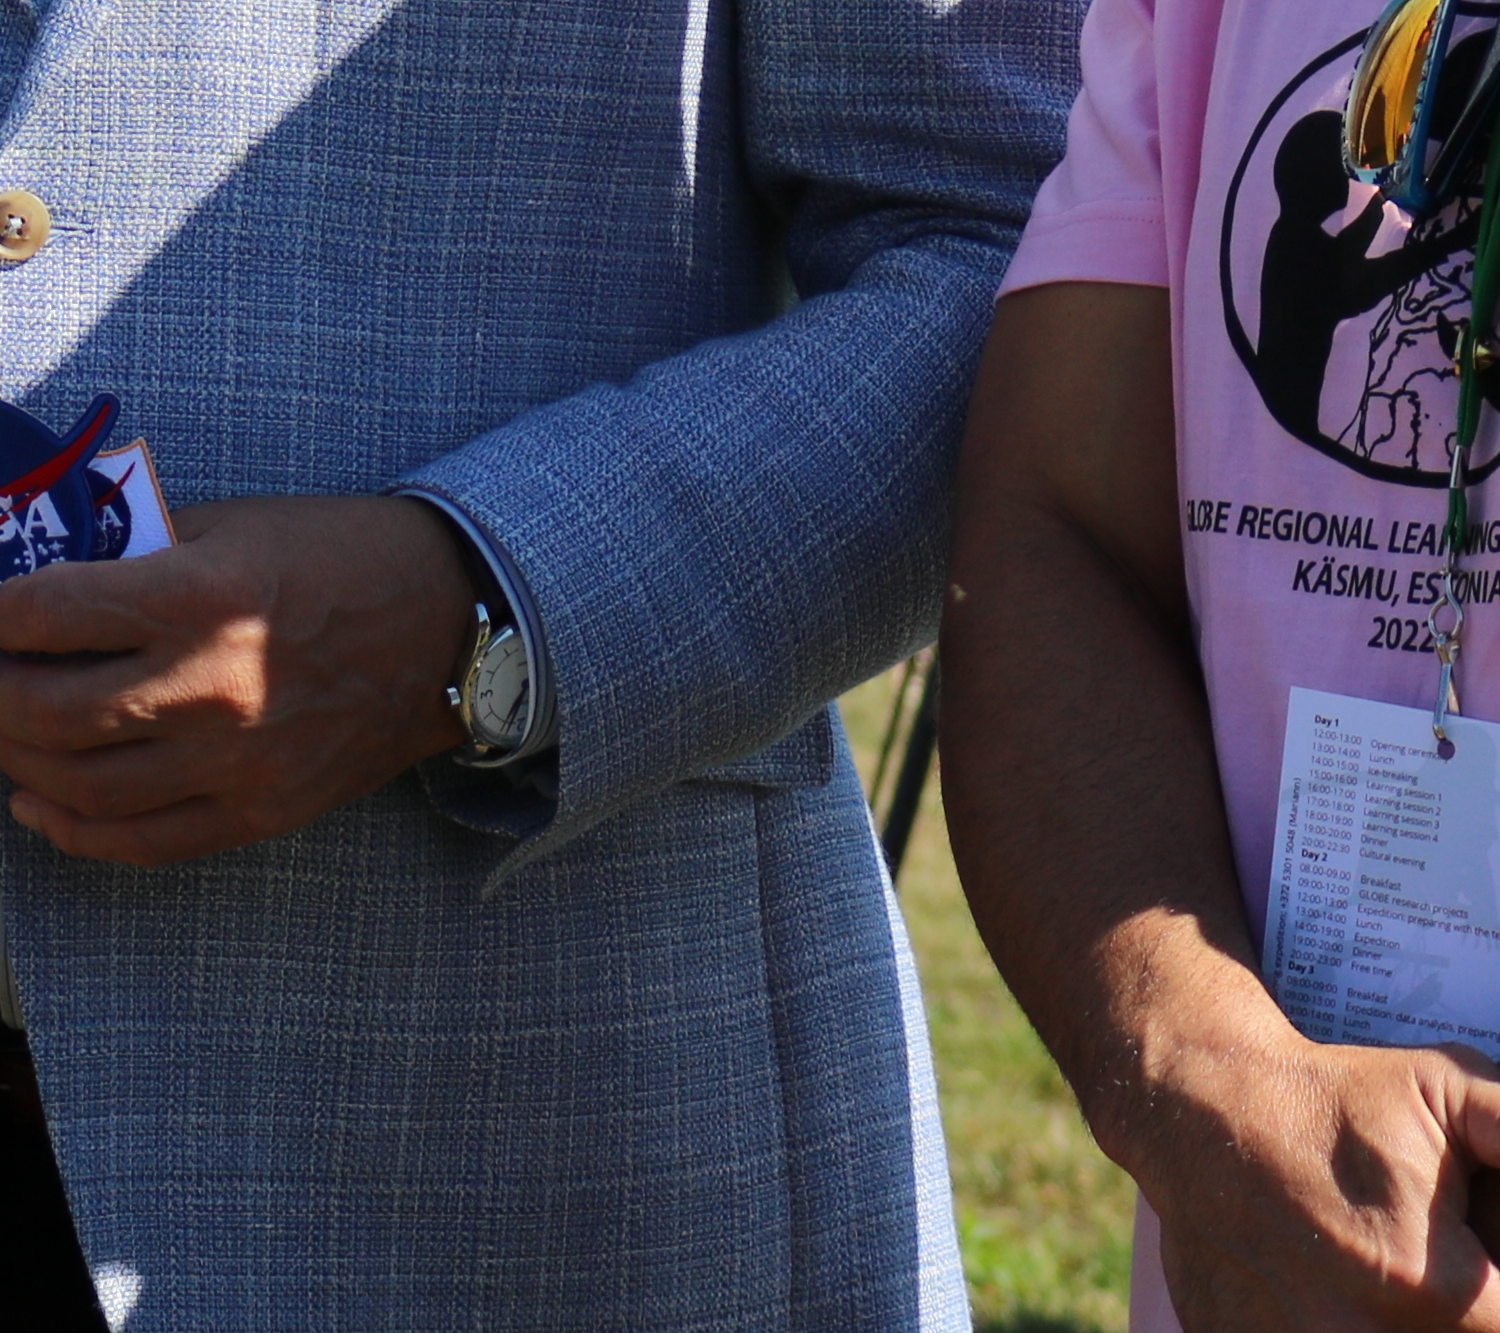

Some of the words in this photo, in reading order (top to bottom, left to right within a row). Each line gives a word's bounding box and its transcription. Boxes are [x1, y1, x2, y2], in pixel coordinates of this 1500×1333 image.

[1235, 504, 1379, 551] REGIONAL
[1292, 555, 1400, 607] KÄSMU,
[1368, 616, 1437, 653] 2022
[1314, 714, 1332, 727] Day
[1335, 718, 1340, 727] 1
[1312, 742, 1361, 759] 13:00-14:00
[1369, 753, 1395, 765] Lunch
[1314, 728, 1362, 745] 12:00-13:00
[1371, 739, 1406, 755] Opening
[1311, 755, 1359, 772] 14:00-15:00
[1367, 767, 1418, 785] Ice-breaking
[1308, 783, 1356, 799] 16:00-17:00
[1365, 793, 1401, 811] Learning
[1403, 801, 1434, 814] session
[1435, 807, 1441, 816] 2
[1310, 769, 1358, 786] 15:00-16:00
[1366, 780, 1402, 797] Learning
[1404, 788, 1435, 801] session
[1438, 793, 1442, 802] 1
[1305, 809, 1354, 826] 18:00-19:00
[1362, 821, 1398, 838] Learning
[1400, 828, 1431, 841] session
[1432, 834, 1439, 843] 4
[1306, 796, 1355, 812] 17:00-18:00
[1363, 807, 1400, 824] Learning
[1401, 815, 1433, 828] session
[1434, 821, 1440, 829] 3
[1303, 823, 1352, 840] 19:00-20:00
[1360, 834, 1389, 848] Dinner
[1301, 836, 1350, 854] 20:00-22:30
[1359, 847, 1391, 862] Cultural
[1392, 856, 1426, 871] evening
[1301, 848, 1320, 862] Day
[1321, 852, 1328, 862] 2
[1283, 857, 1293, 882] 5301
[1300, 862, 1351, 881] 08:00-09:00
[1360, 874, 1402, 891] Breakfast
[1280, 884, 1290, 909] +372
[1298, 876, 1350, 896] 09:00-12:00
[1358, 889, 1390, 904] GLOBE
[1391, 896, 1431, 912] research
[1432, 903, 1469, 919] projects
[1296, 905, 1347, 924] 13:00-14:00
[1355, 917, 1383, 932] Lunch
[1297, 891, 1348, 910] 12:00-13:00
[1357, 903, 1406, 922] Expedition:
[1407, 914, 1452, 932] preparing
[1453, 923, 1473, 934] with
[1474, 926, 1490, 938] the
[1292, 934, 1344, 954] 19:00-20:00
[1352, 946, 1383, 961] Dinner
[1294, 920, 1345, 939] 14:00-19:00
[1354, 932, 1400, 950] Expedition
[1288, 960, 1306, 975] Day
[1308, 965, 1315, 975] 3
[1290, 948, 1342, 968] 20:00-23:00
[1351, 960, 1370, 974] Free
[1372, 965, 1393, 979] time
[1347, 987, 1388, 1005] Breakfast
[1343, 1017, 1371, 1030] Lunch
[1345, 1001, 1394, 1020] Expedition:
[1396, 1012, 1417, 1025] data
